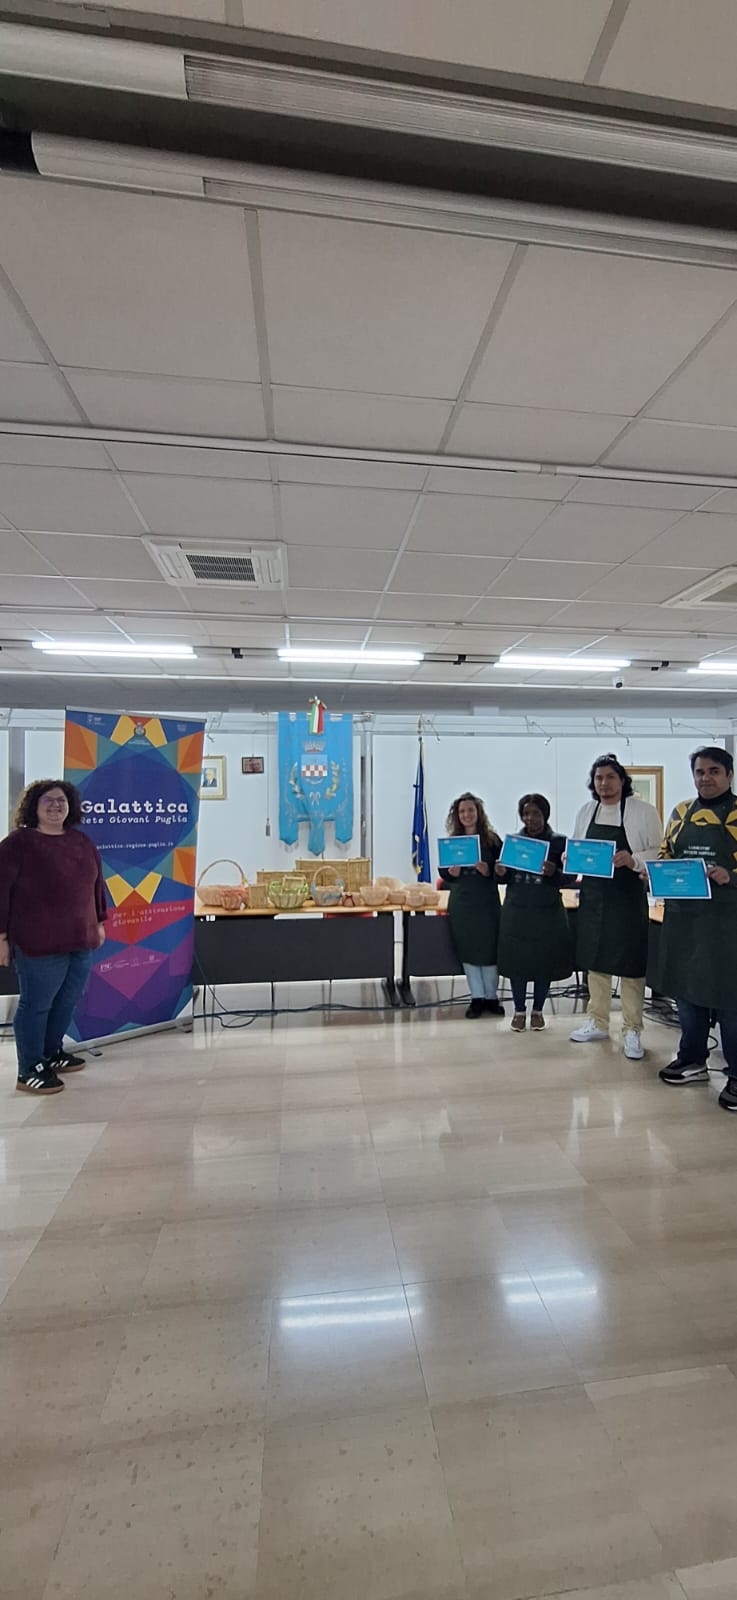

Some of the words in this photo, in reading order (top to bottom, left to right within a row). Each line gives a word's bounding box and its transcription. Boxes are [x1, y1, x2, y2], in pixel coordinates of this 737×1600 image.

[81, 799, 188, 813] Galattica
[109, 815, 150, 824] Giovani
[155, 815, 188, 825] Puglia
